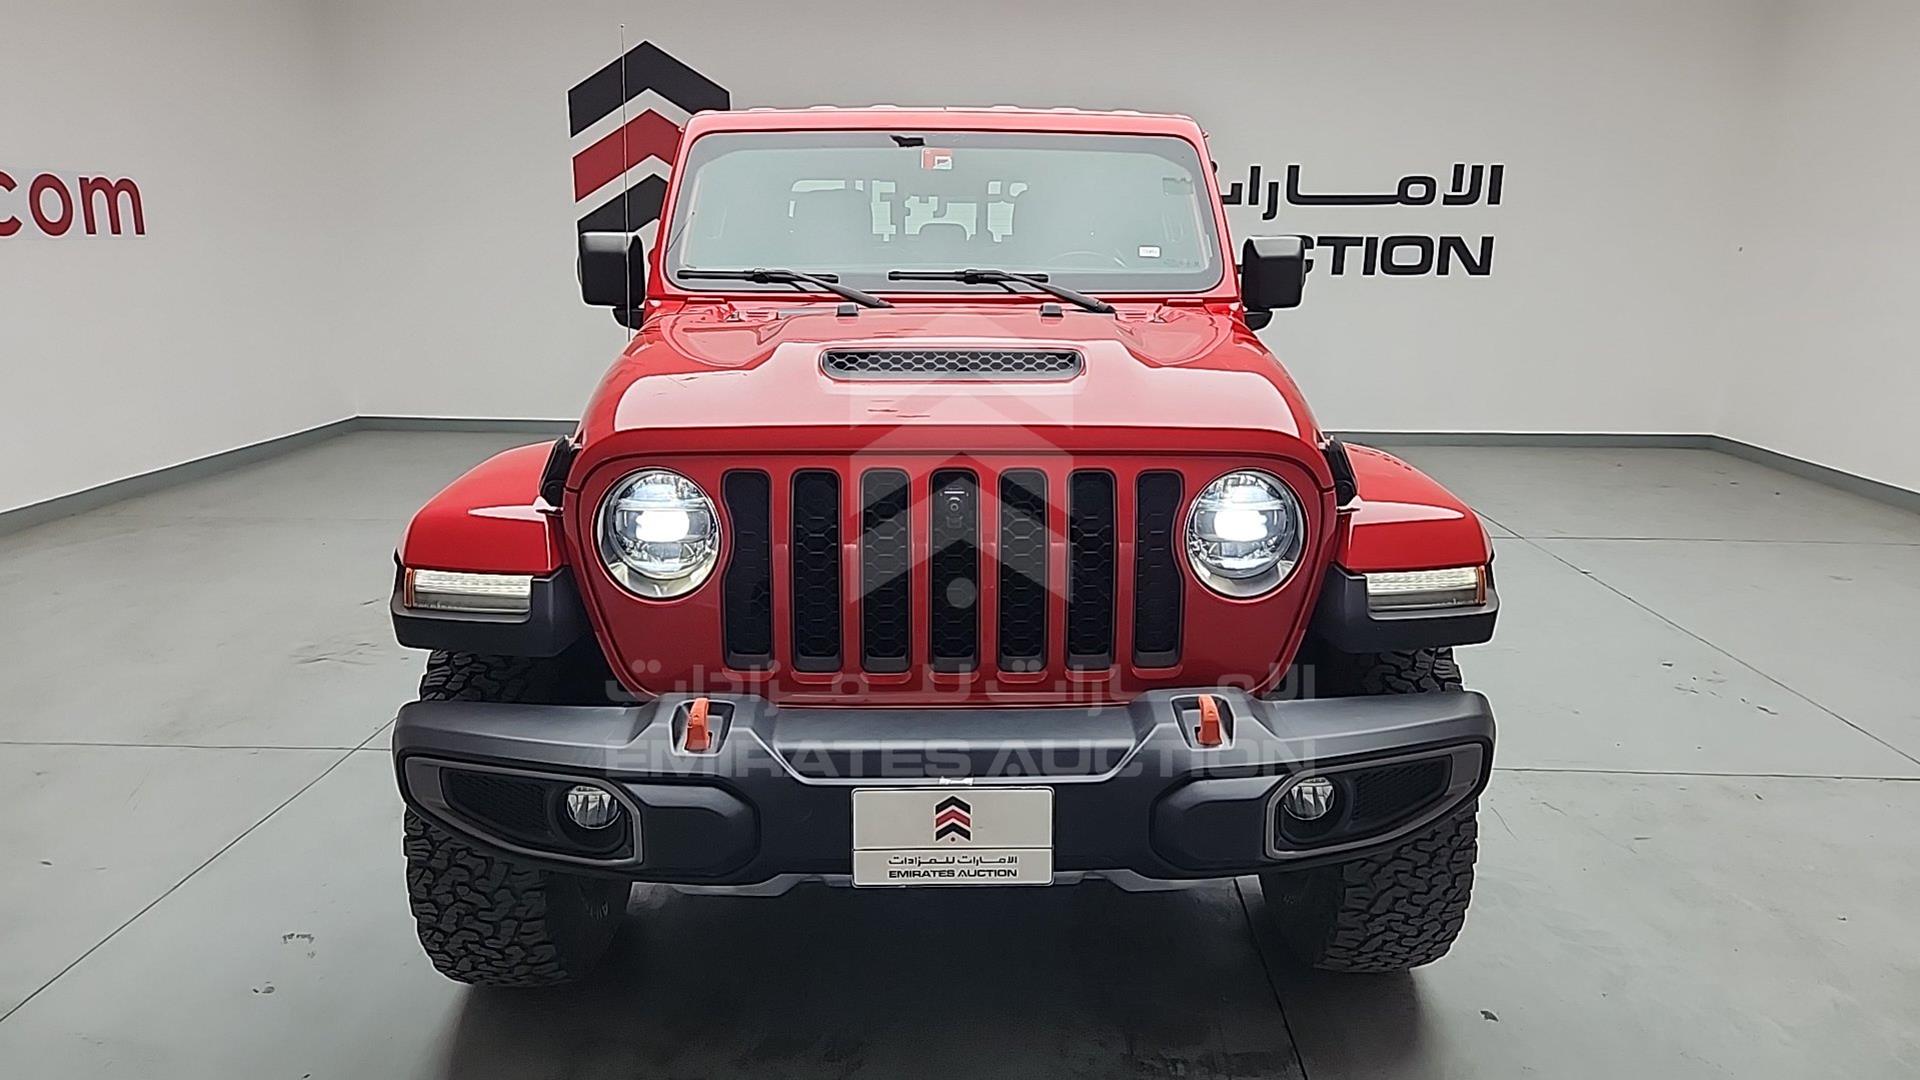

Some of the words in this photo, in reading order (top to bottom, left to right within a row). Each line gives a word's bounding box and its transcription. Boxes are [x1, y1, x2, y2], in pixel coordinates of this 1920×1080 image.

[1222, 164, 1503, 220] الامارا
[1303, 235, 1494, 276] TION
[889, 870, 955, 878] EMIRATES
[958, 869, 1017, 877] AUCTION
